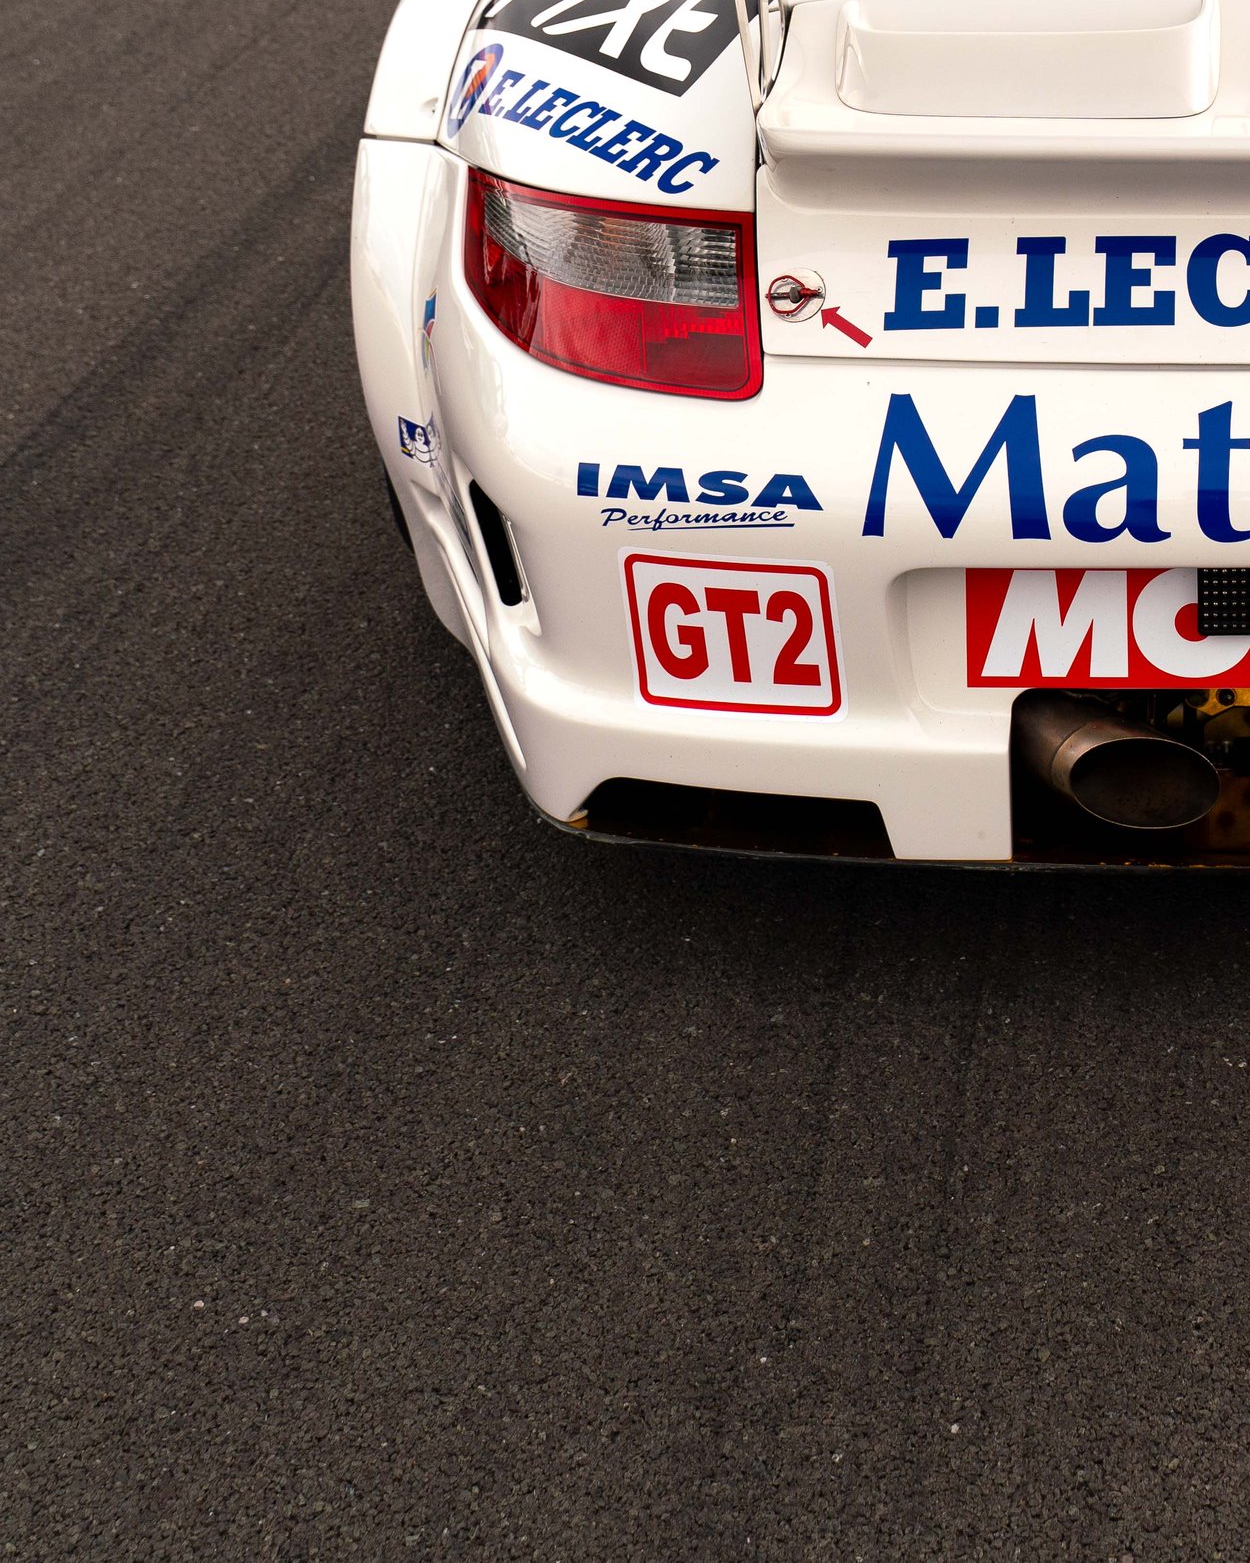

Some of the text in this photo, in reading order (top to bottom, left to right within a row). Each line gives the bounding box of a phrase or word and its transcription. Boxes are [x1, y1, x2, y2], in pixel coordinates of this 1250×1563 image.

[478, 69, 720, 194] E.LECLERC
[577, 462, 824, 511] IMSA
[600, 507, 794, 531] Performance
[647, 582, 822, 686] GT2
